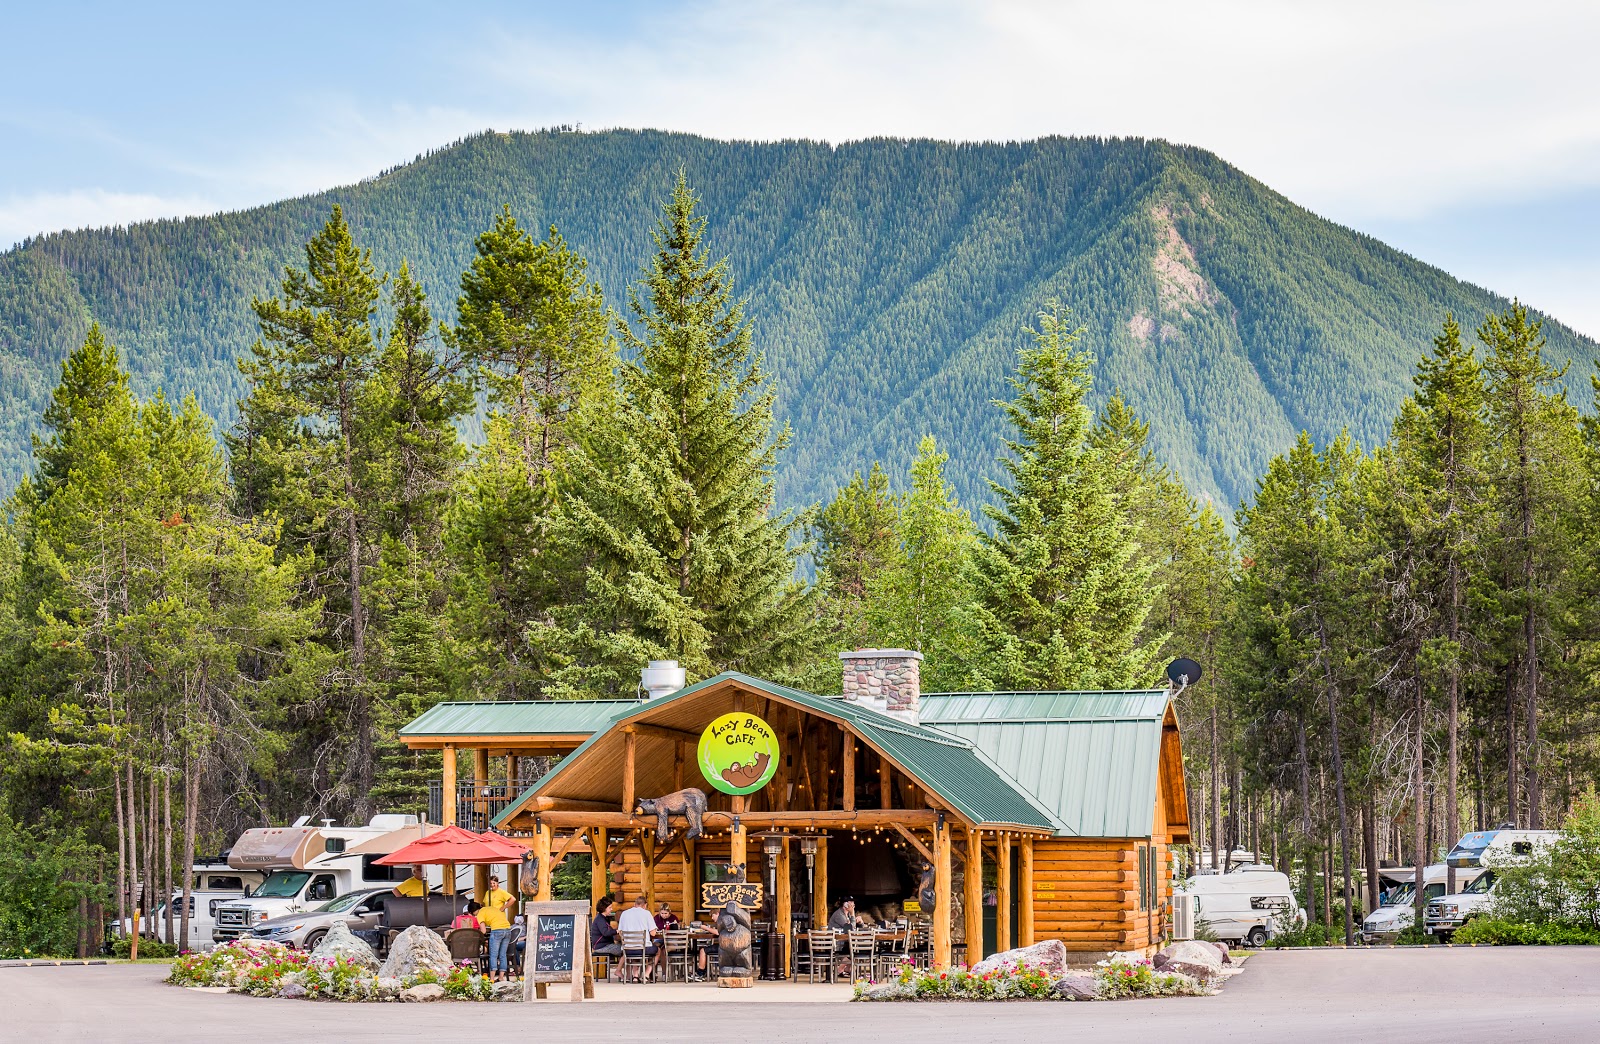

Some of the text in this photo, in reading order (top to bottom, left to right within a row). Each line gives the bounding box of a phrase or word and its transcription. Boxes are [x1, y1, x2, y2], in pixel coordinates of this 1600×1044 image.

[711, 718, 770, 739] Lazy Bear
[725, 733, 756, 746] CAFE
[709, 885, 756, 897] Lazy Bear
[718, 892, 743, 902] CAFE
